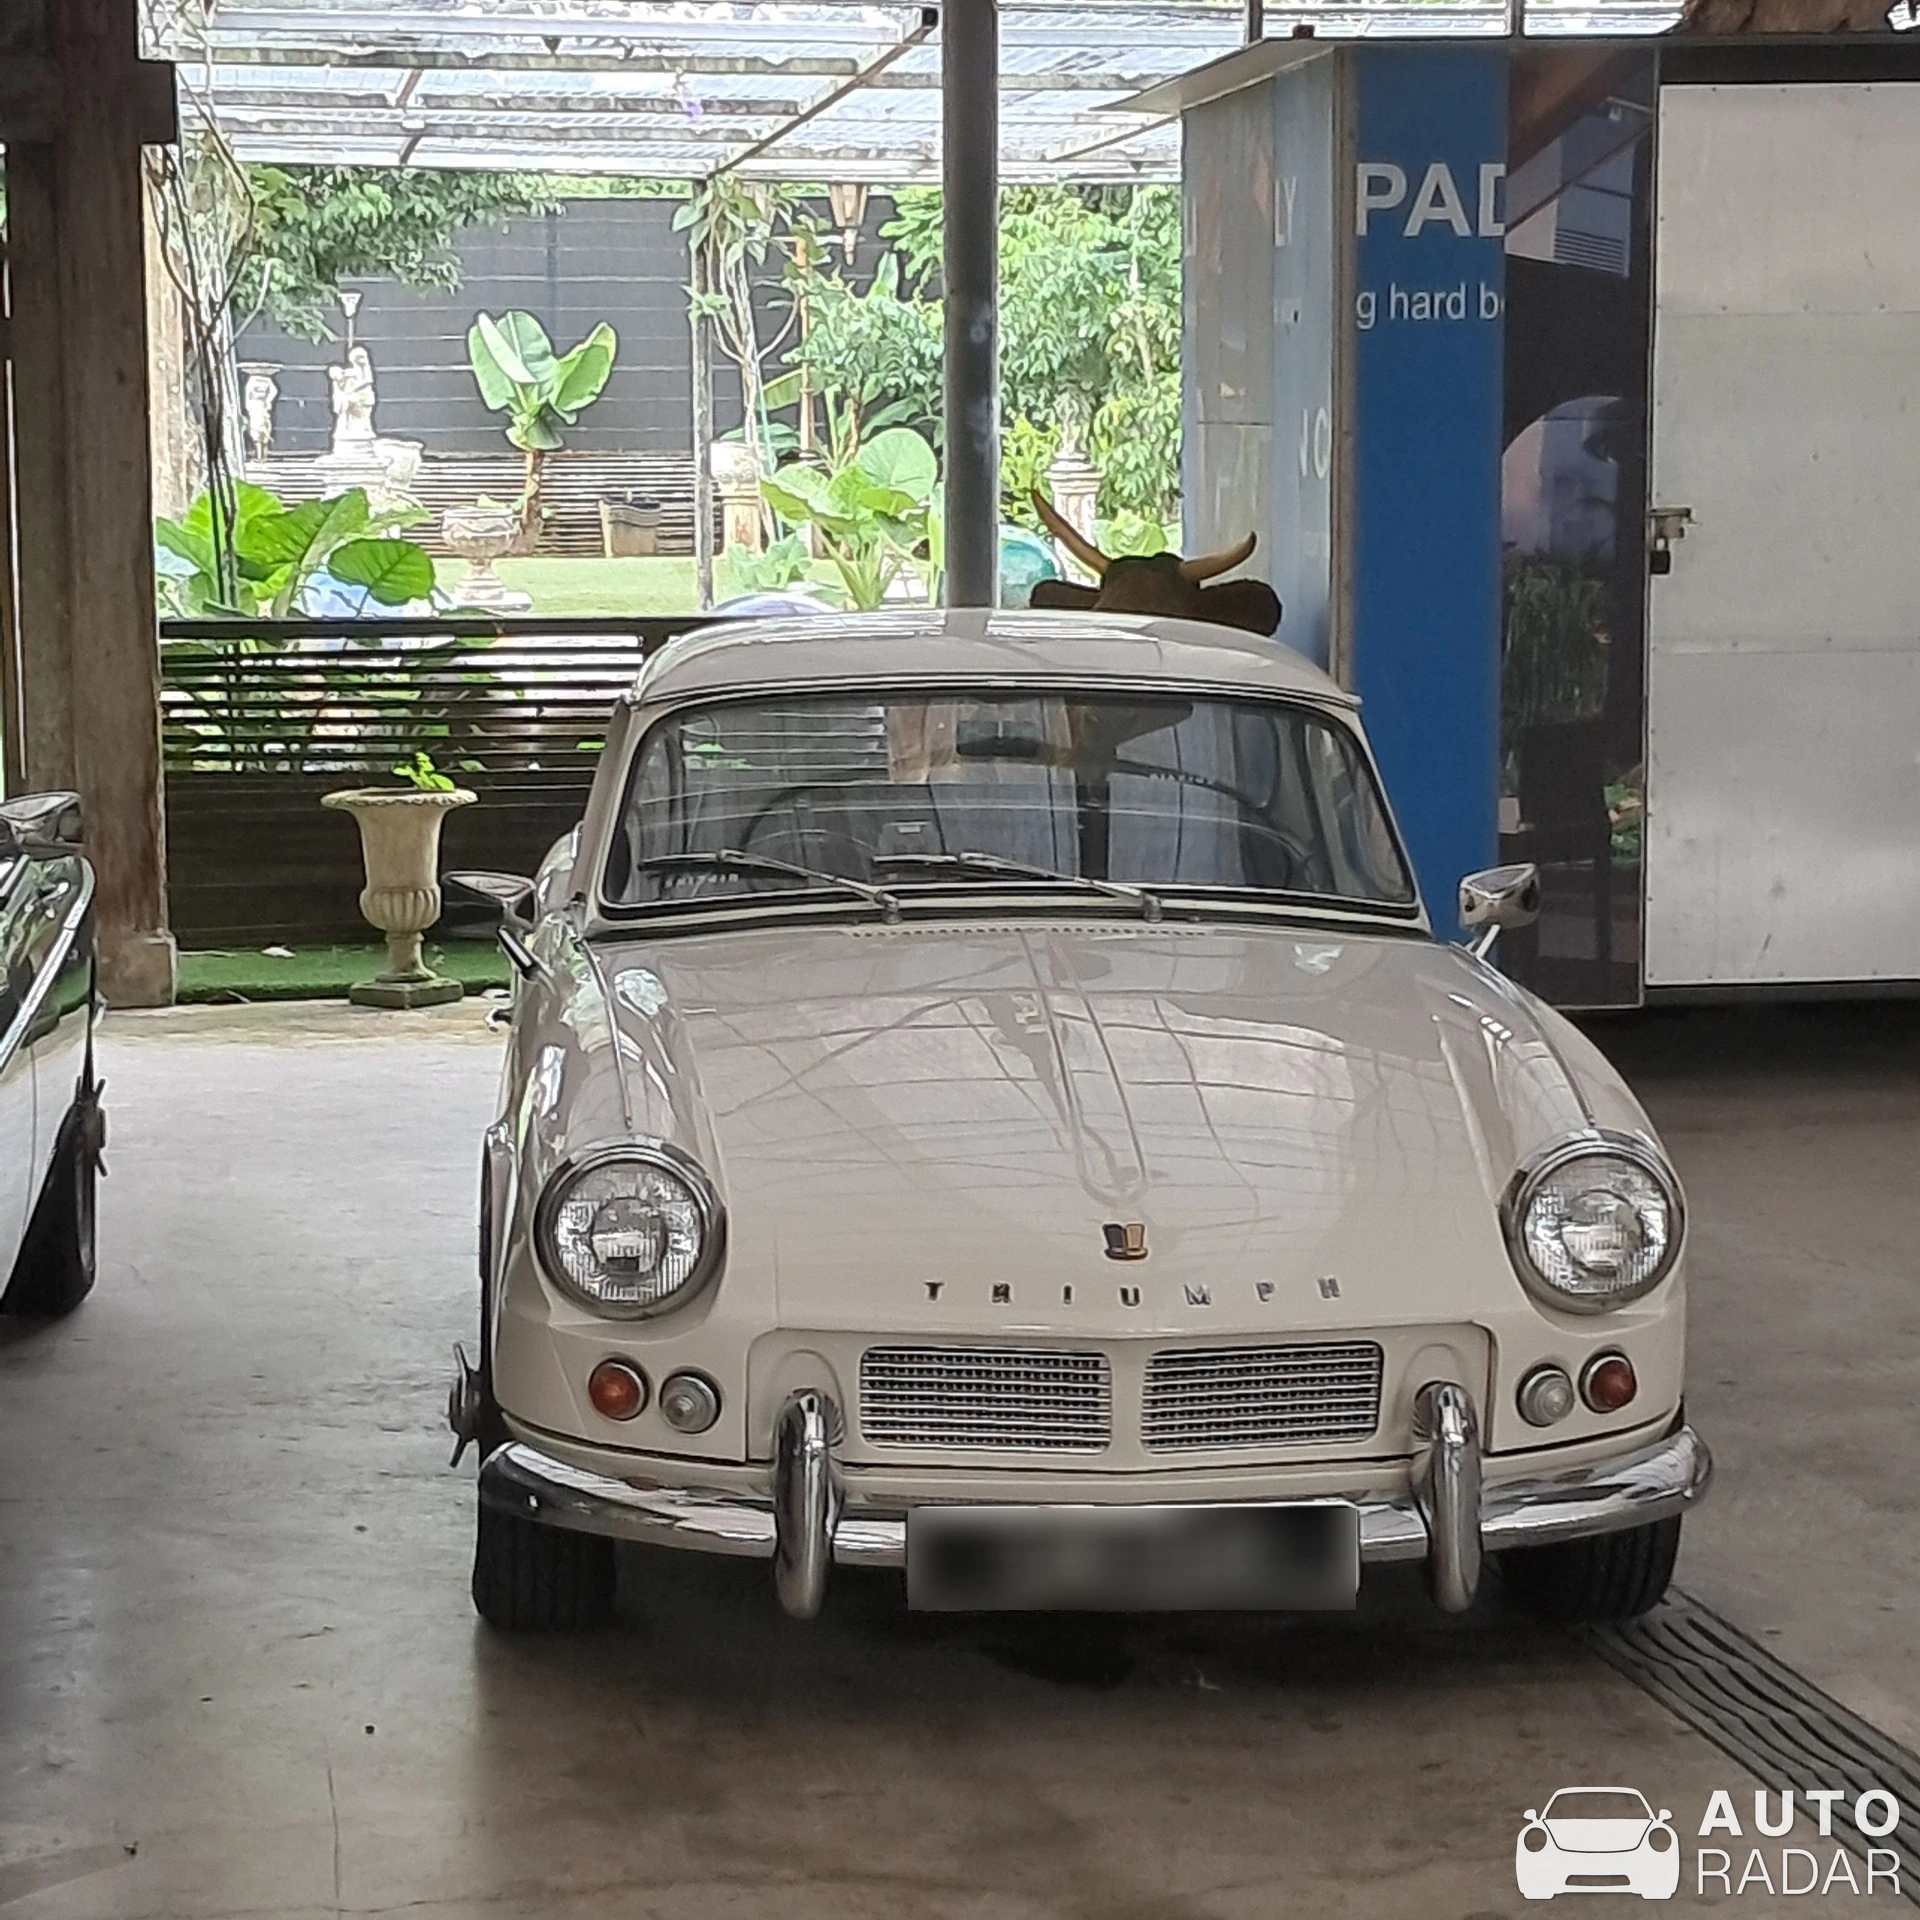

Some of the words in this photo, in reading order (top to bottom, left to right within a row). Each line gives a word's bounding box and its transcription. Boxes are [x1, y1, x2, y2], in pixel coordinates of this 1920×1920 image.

[1390, 282, 1467, 320] hard
[1479, 281, 1505, 320] b
[923, 1276, 1341, 1307] TRIUMPH
